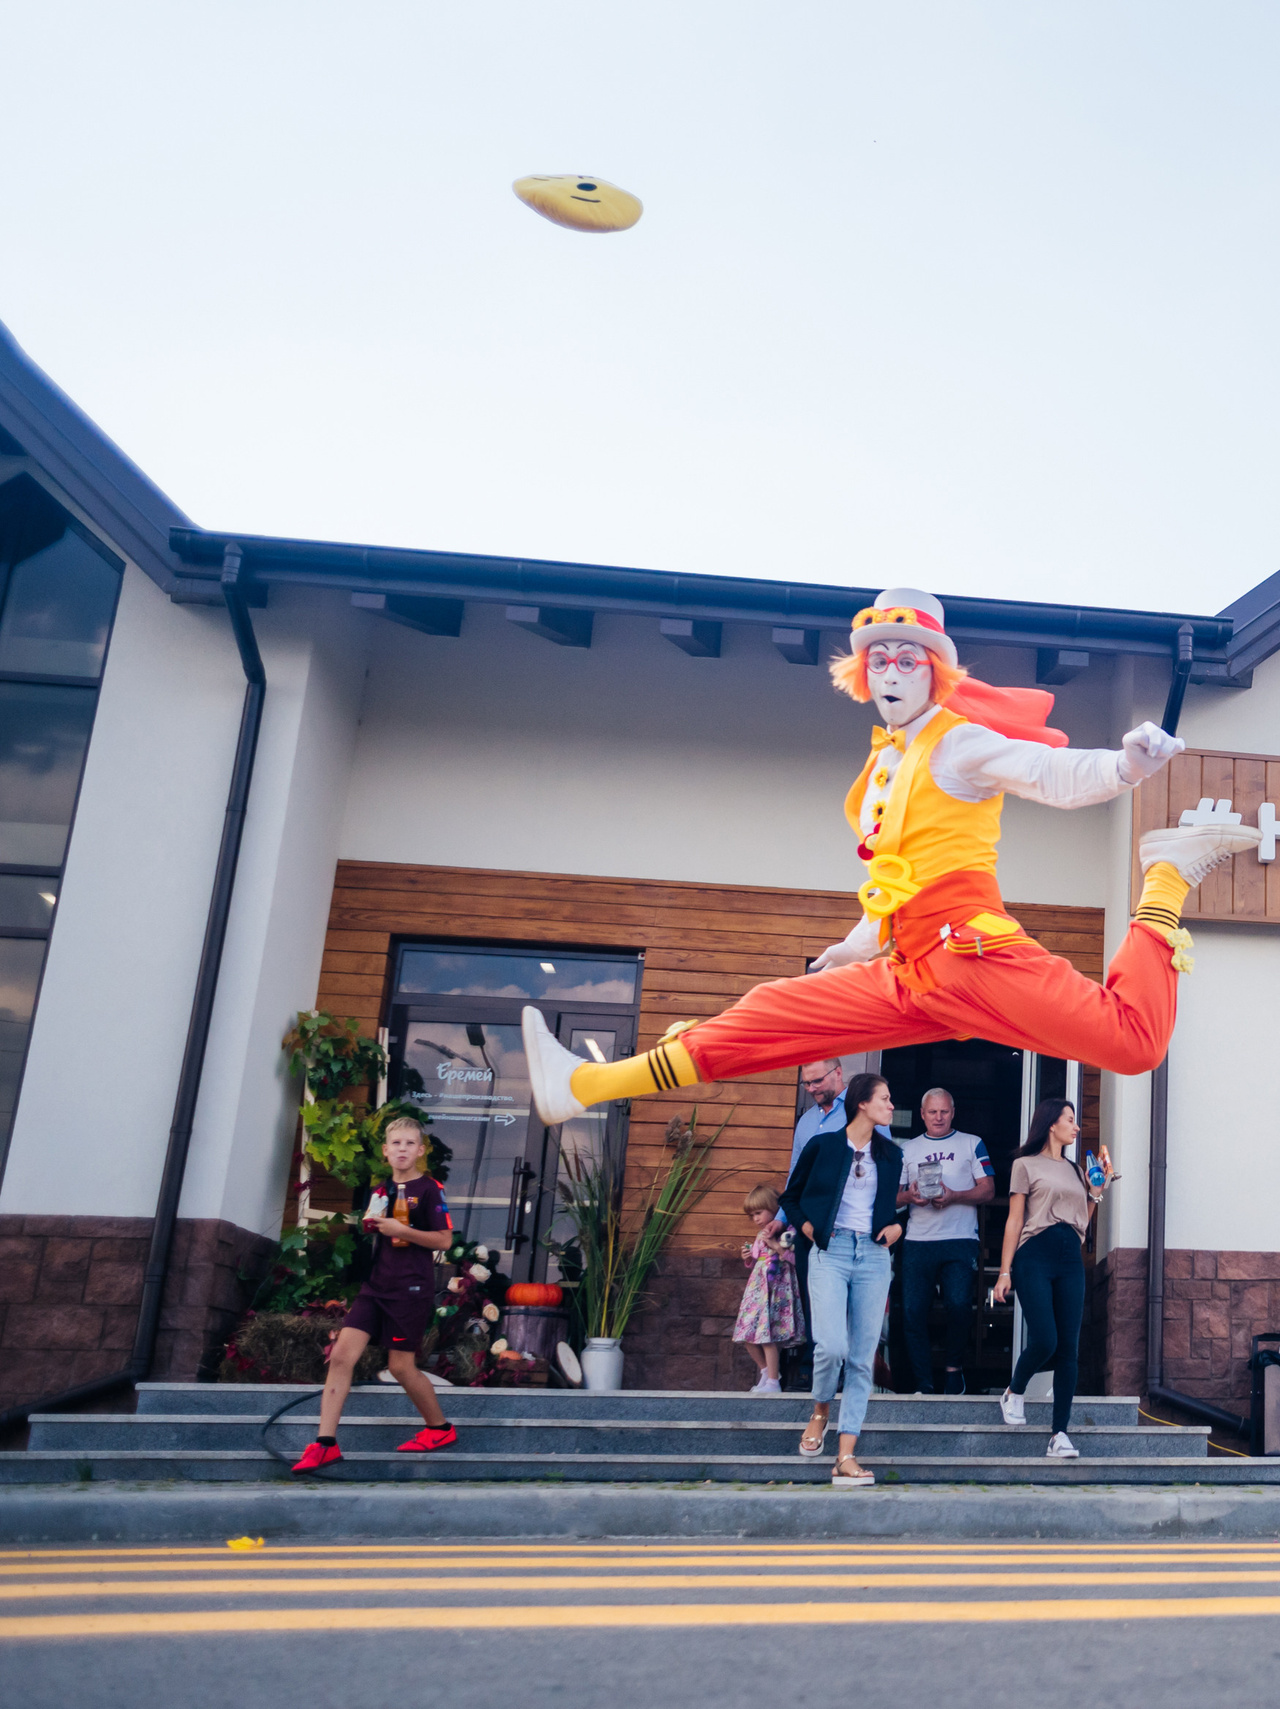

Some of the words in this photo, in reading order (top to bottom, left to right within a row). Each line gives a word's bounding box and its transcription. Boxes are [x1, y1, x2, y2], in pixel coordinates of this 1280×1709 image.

[436, 1062, 493, 1085] Еремей
[412, 1091, 432, 1099] Здесь
[925, 1152, 955, 1162] FILA
